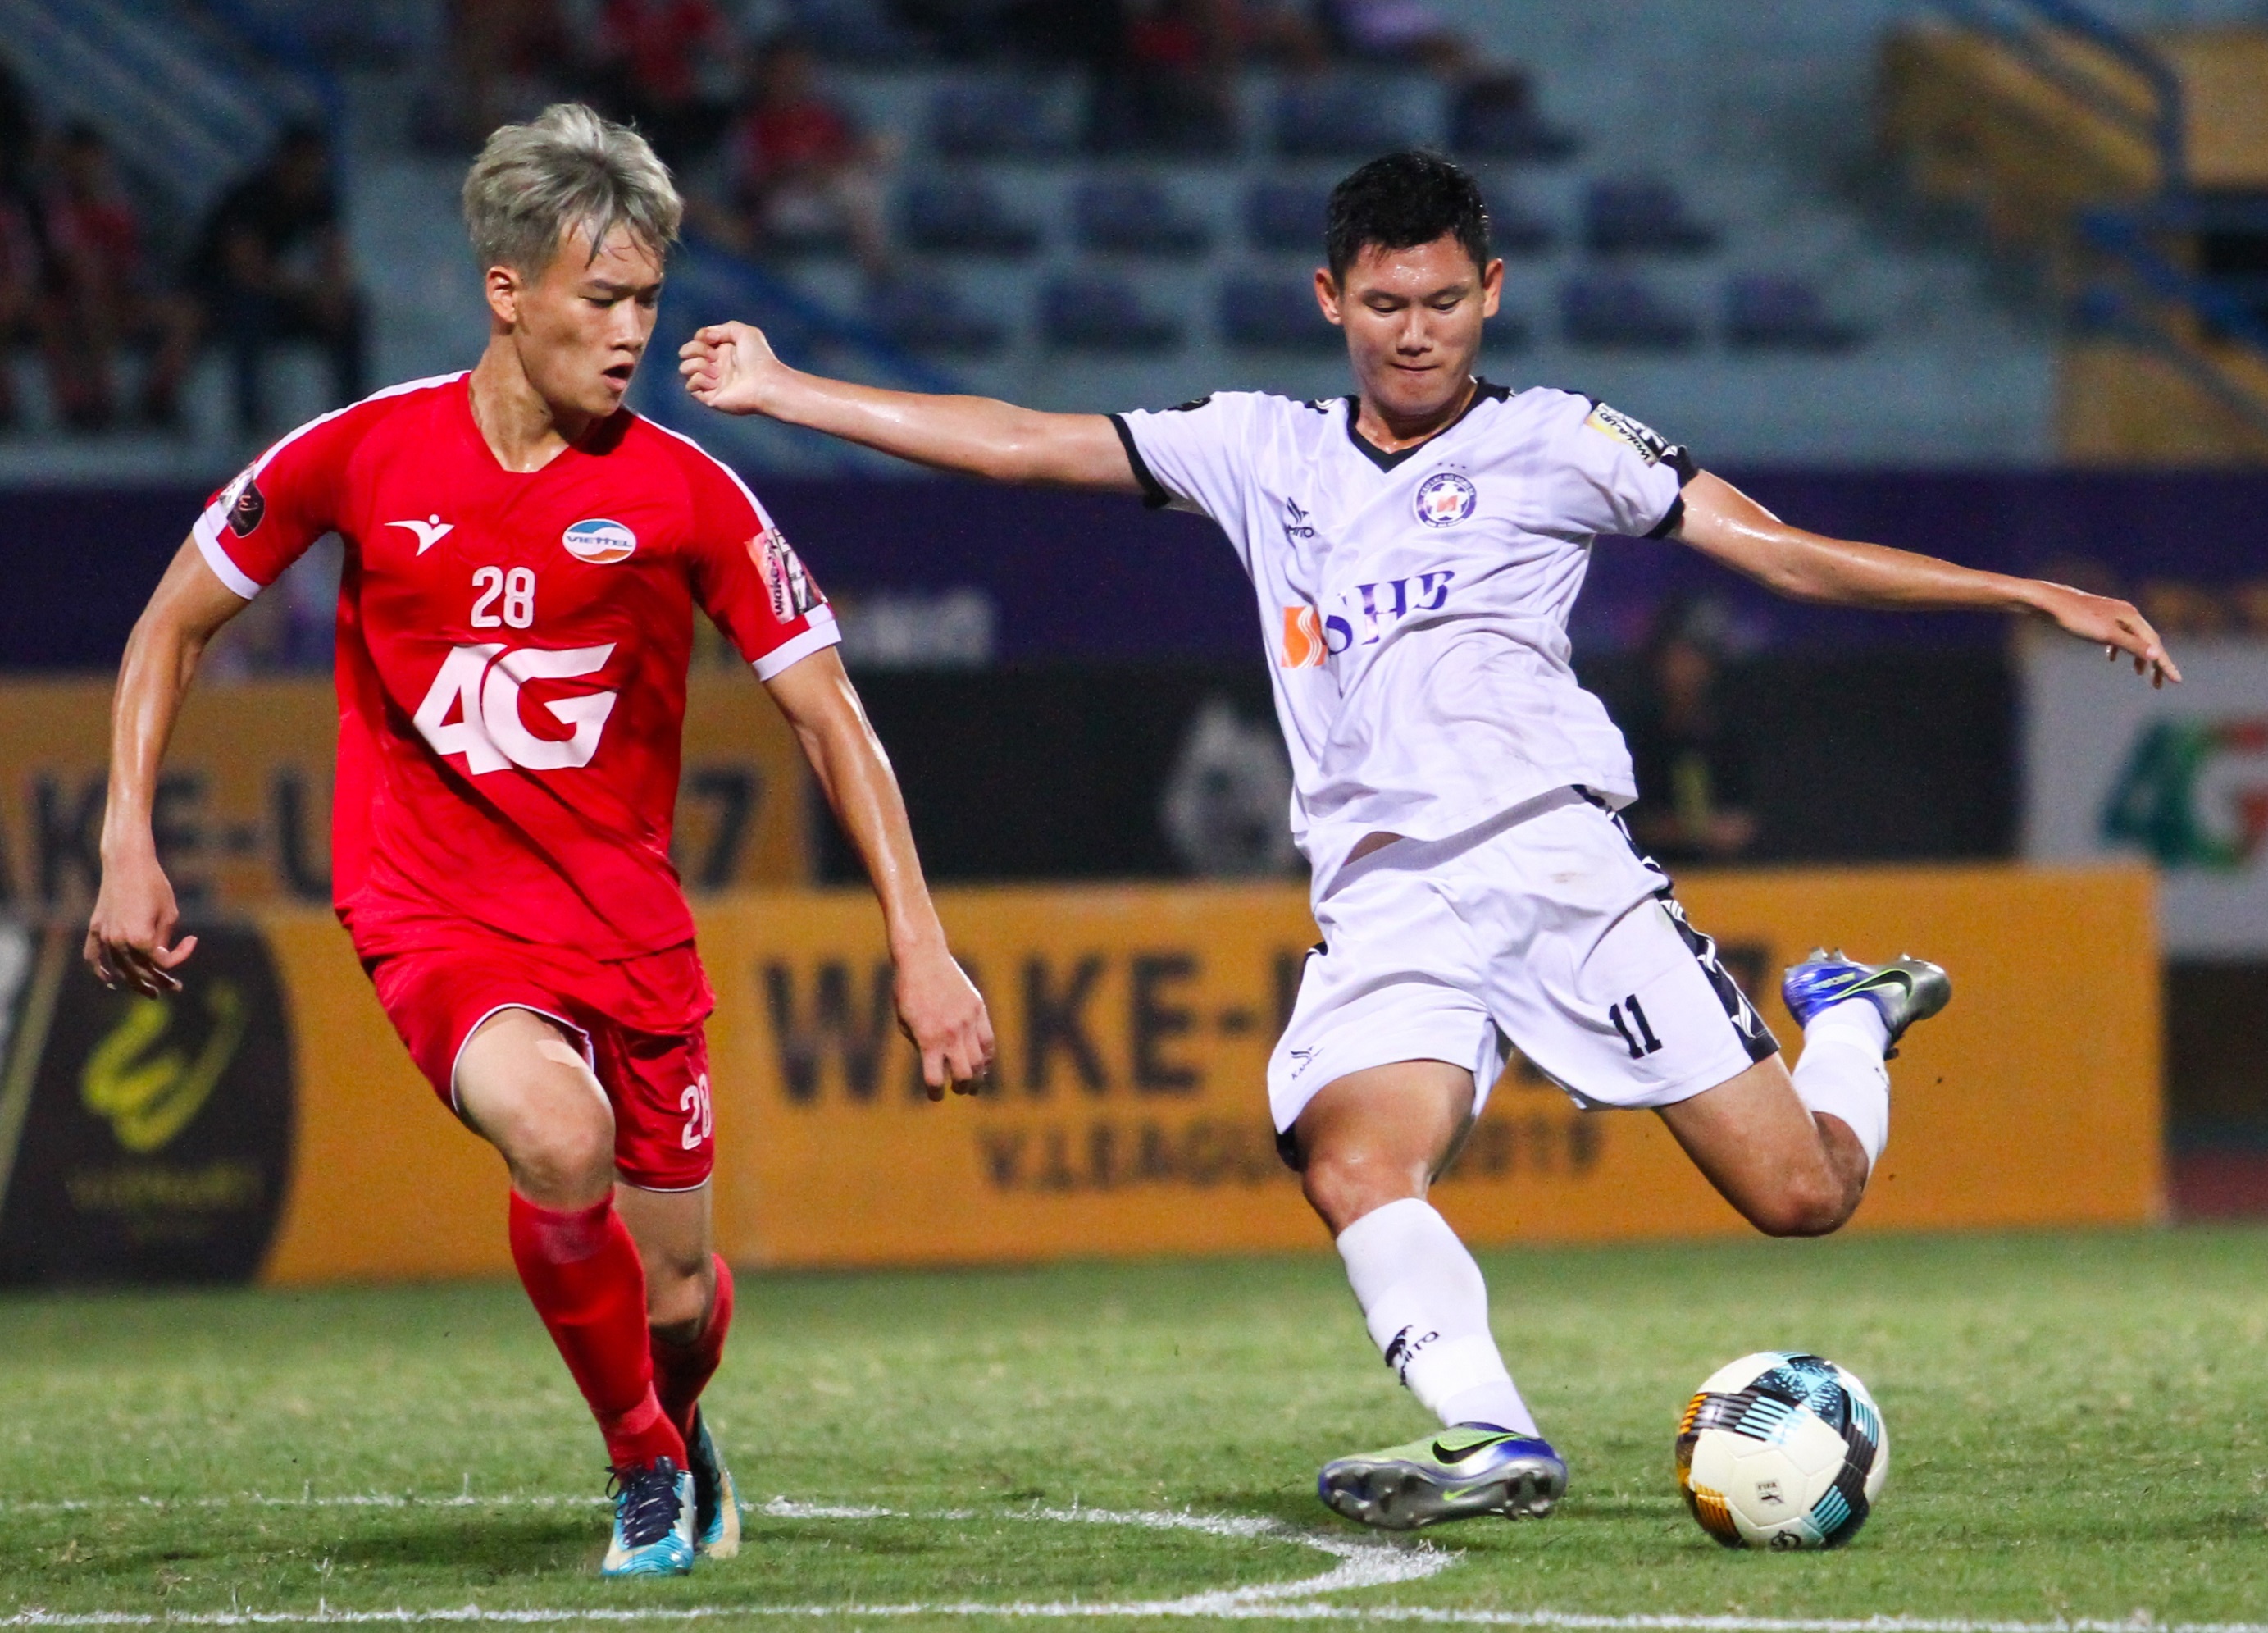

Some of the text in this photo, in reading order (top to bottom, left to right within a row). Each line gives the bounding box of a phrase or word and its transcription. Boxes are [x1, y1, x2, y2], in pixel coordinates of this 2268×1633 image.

[470, 565, 535, 629] 28
[412, 642, 617, 775] 4G
[1608, 993, 1664, 1060] 11
[680, 1073, 712, 1151] 28
